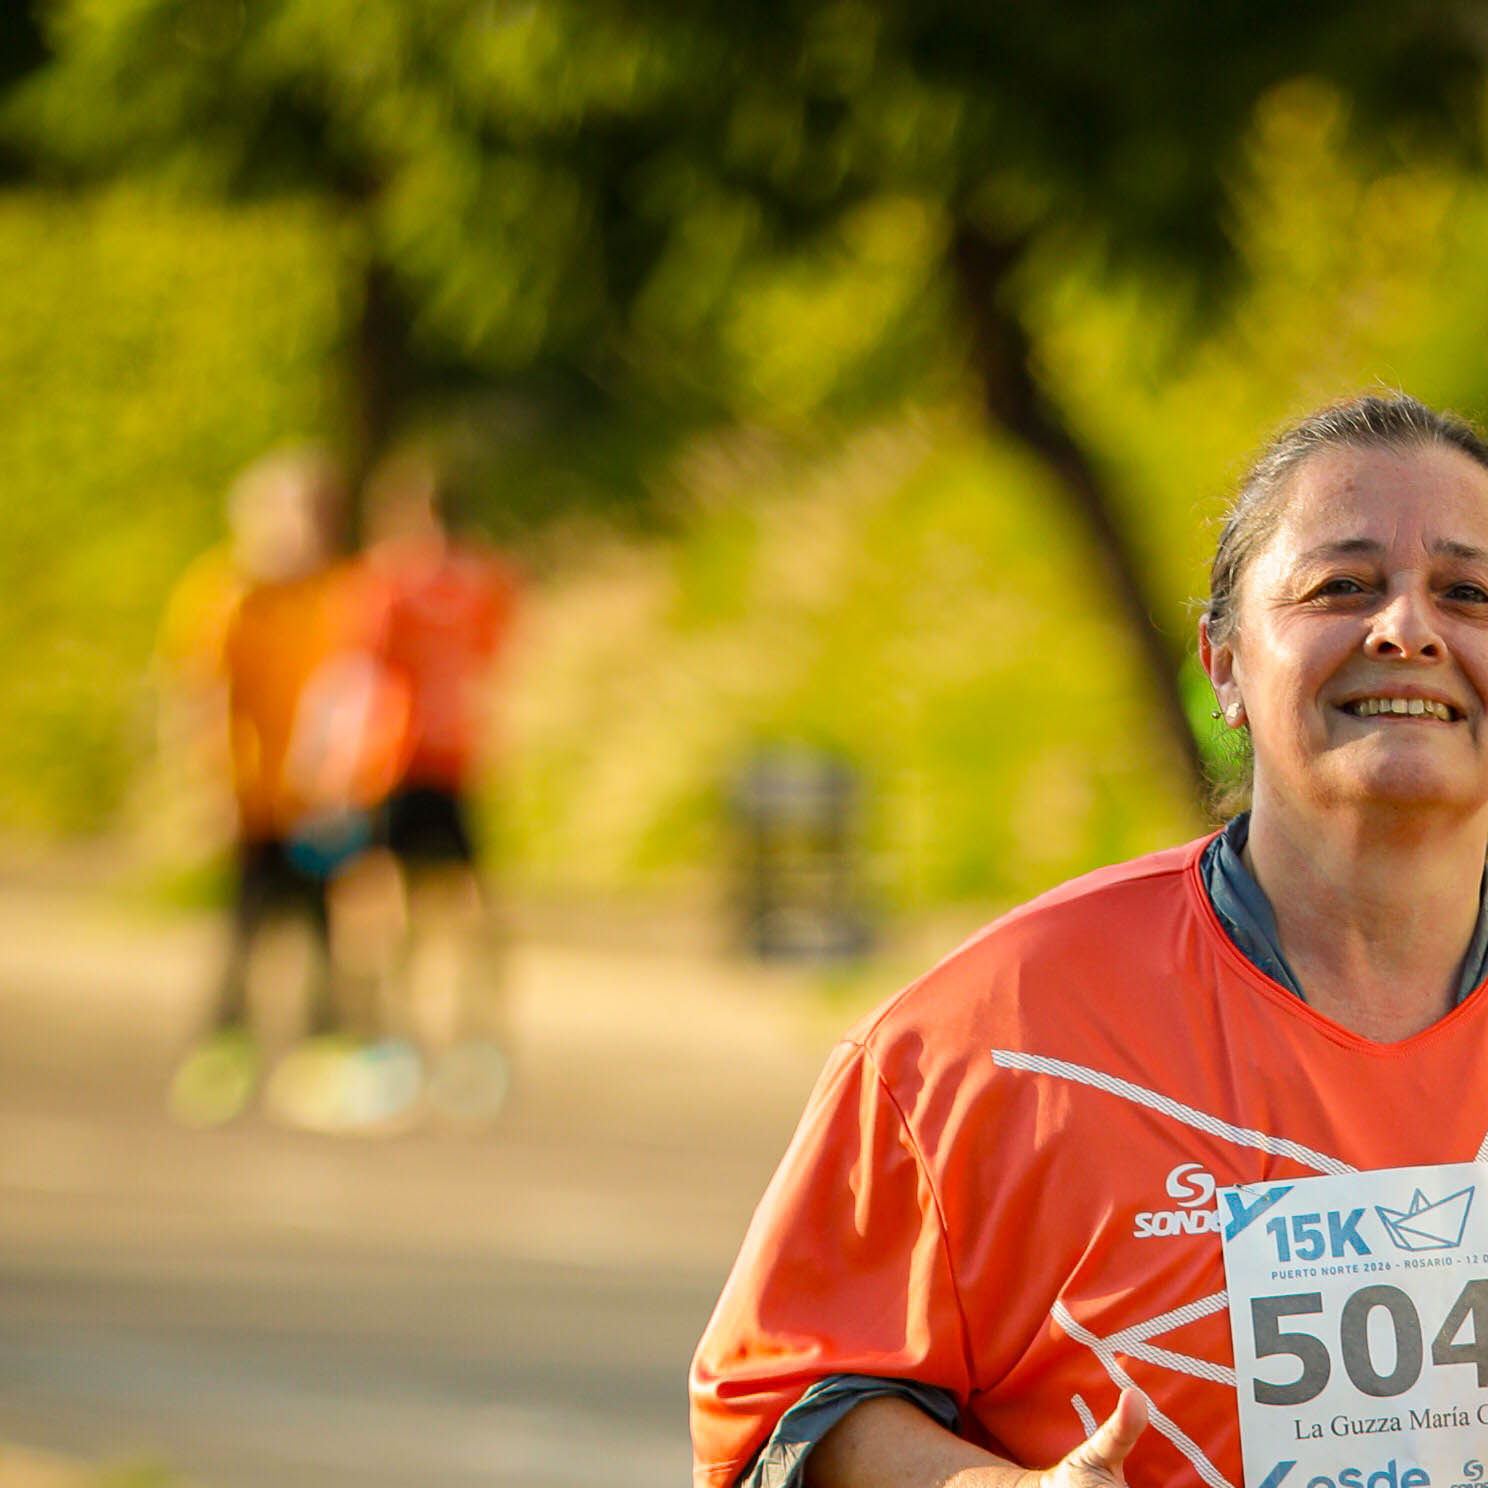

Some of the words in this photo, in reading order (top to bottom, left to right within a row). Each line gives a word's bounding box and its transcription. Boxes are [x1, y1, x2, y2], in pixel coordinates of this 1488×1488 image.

[1266, 1207, 1372, 1263] 15K
[1272, 1268, 1317, 1280] PUERTO
[1321, 1264, 1359, 1275] NORTE
[1364, 1261, 1391, 1272] 2026
[1404, 1257, 1452, 1268] ROSARIO
[1466, 1254, 1478, 1264] 12
[1295, 1418, 1324, 1440] La
[1330, 1414, 1402, 1437] Guzza
[1409, 1405, 1470, 1430] María
